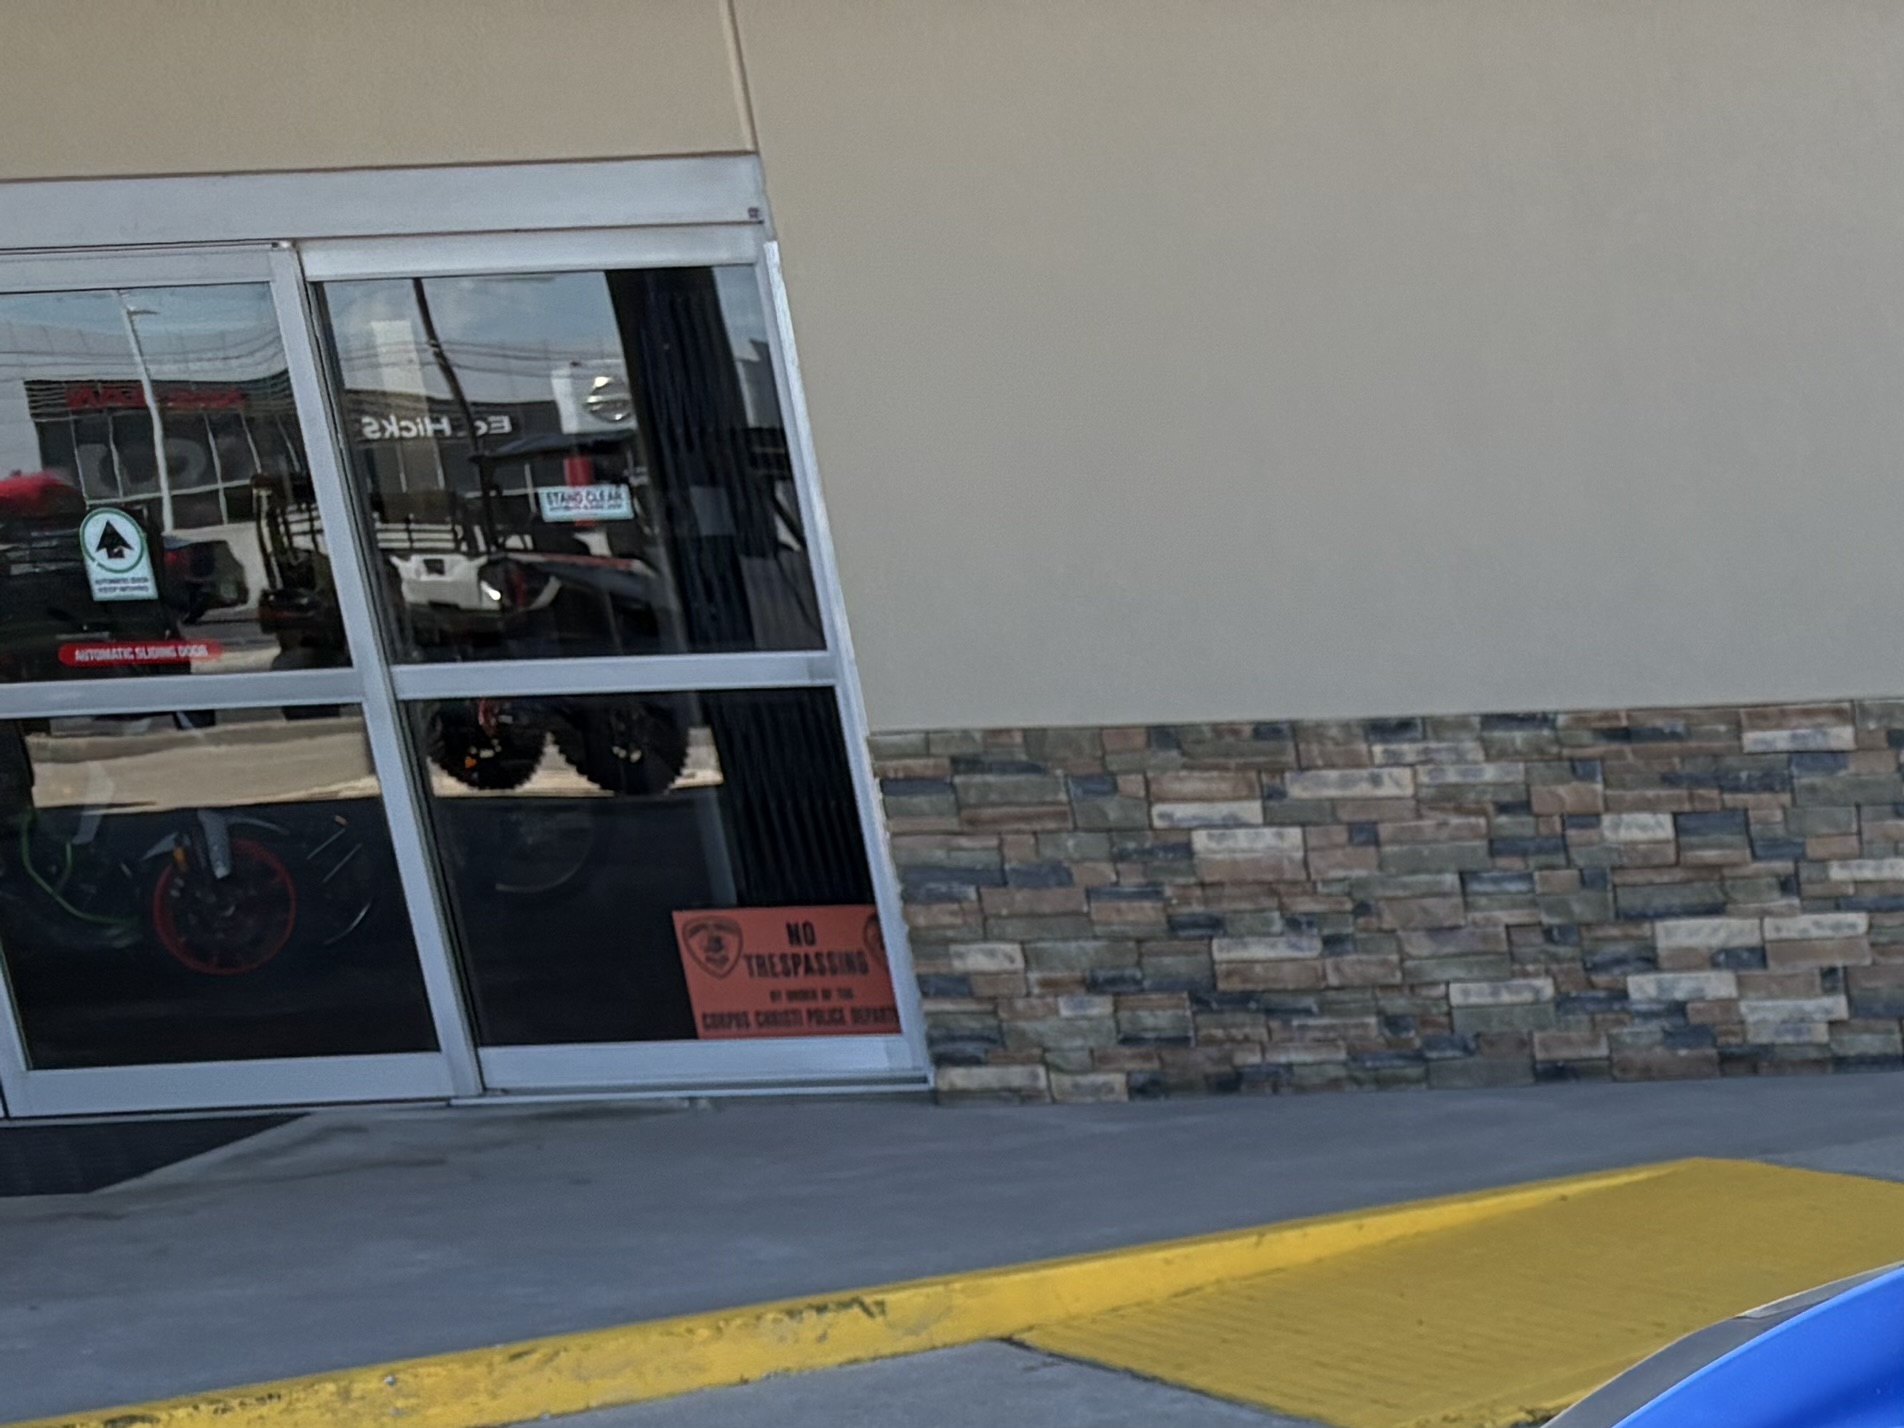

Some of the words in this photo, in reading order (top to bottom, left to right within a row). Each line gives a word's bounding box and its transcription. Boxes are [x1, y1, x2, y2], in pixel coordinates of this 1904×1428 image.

[75, 647, 134, 662] AUTOMATIC
[135, 645, 176, 660] SLIDING
[178, 643, 208, 658] DOOR
[784, 920, 817, 947] NO
[743, 951, 870, 978] TRESPASSING
